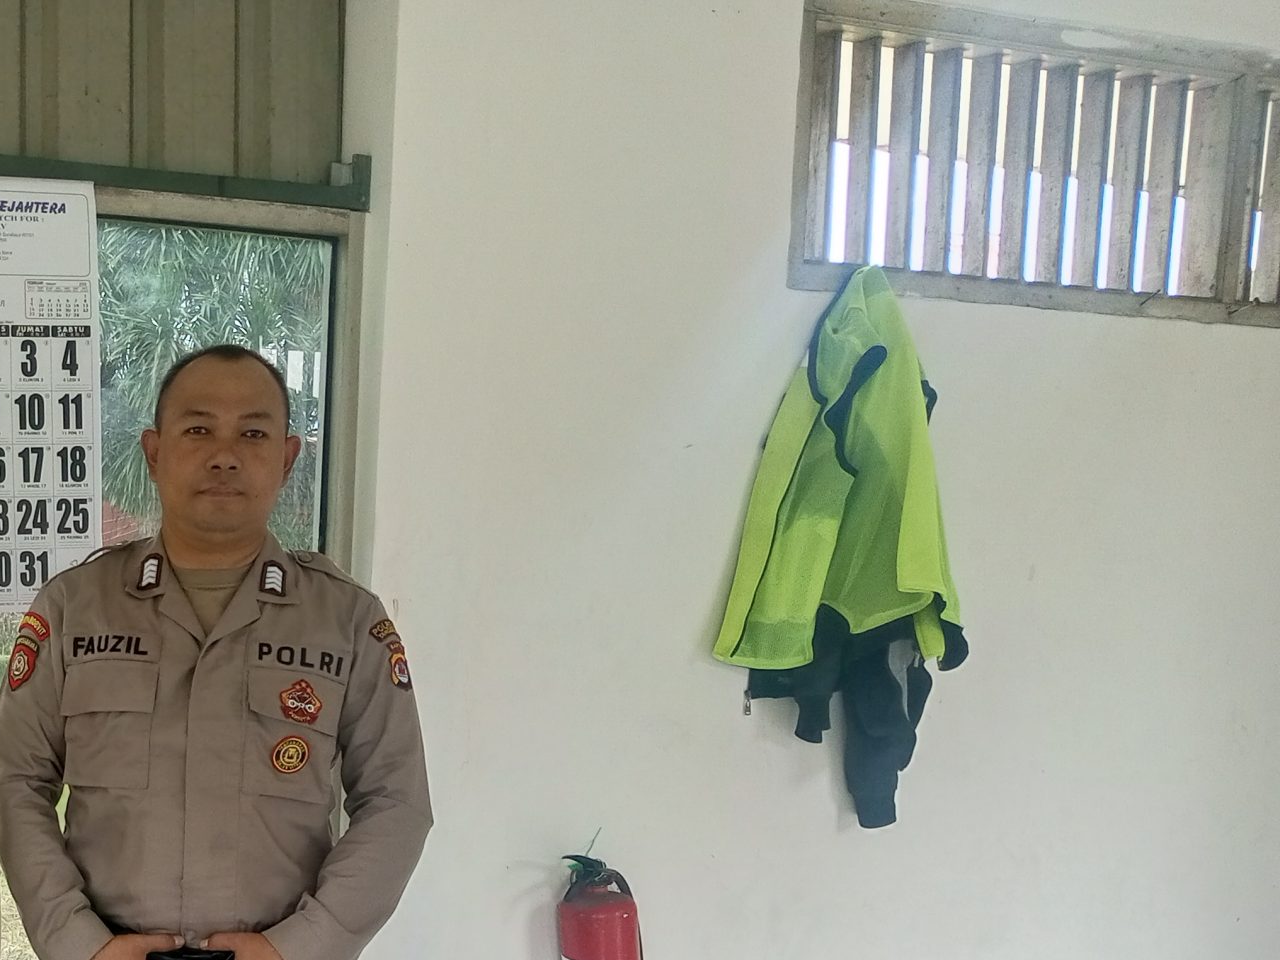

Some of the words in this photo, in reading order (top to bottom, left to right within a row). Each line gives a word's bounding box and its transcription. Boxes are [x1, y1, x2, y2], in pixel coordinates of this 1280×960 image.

[20, 215, 39, 223] FOR
[20, 339, 38, 378] 3
[61, 340, 79, 377] 4
[14, 393, 45, 431] 10
[58, 393, 83, 430] 11
[17, 446, 44, 483] 17
[56, 446, 87, 483] 18
[16, 499, 50, 536] 24
[56, 498, 89, 535] 25
[19, 551, 49, 587] 31
[72, 634, 148, 657] FAUZIL
[258, 642, 343, 677] POLRI
